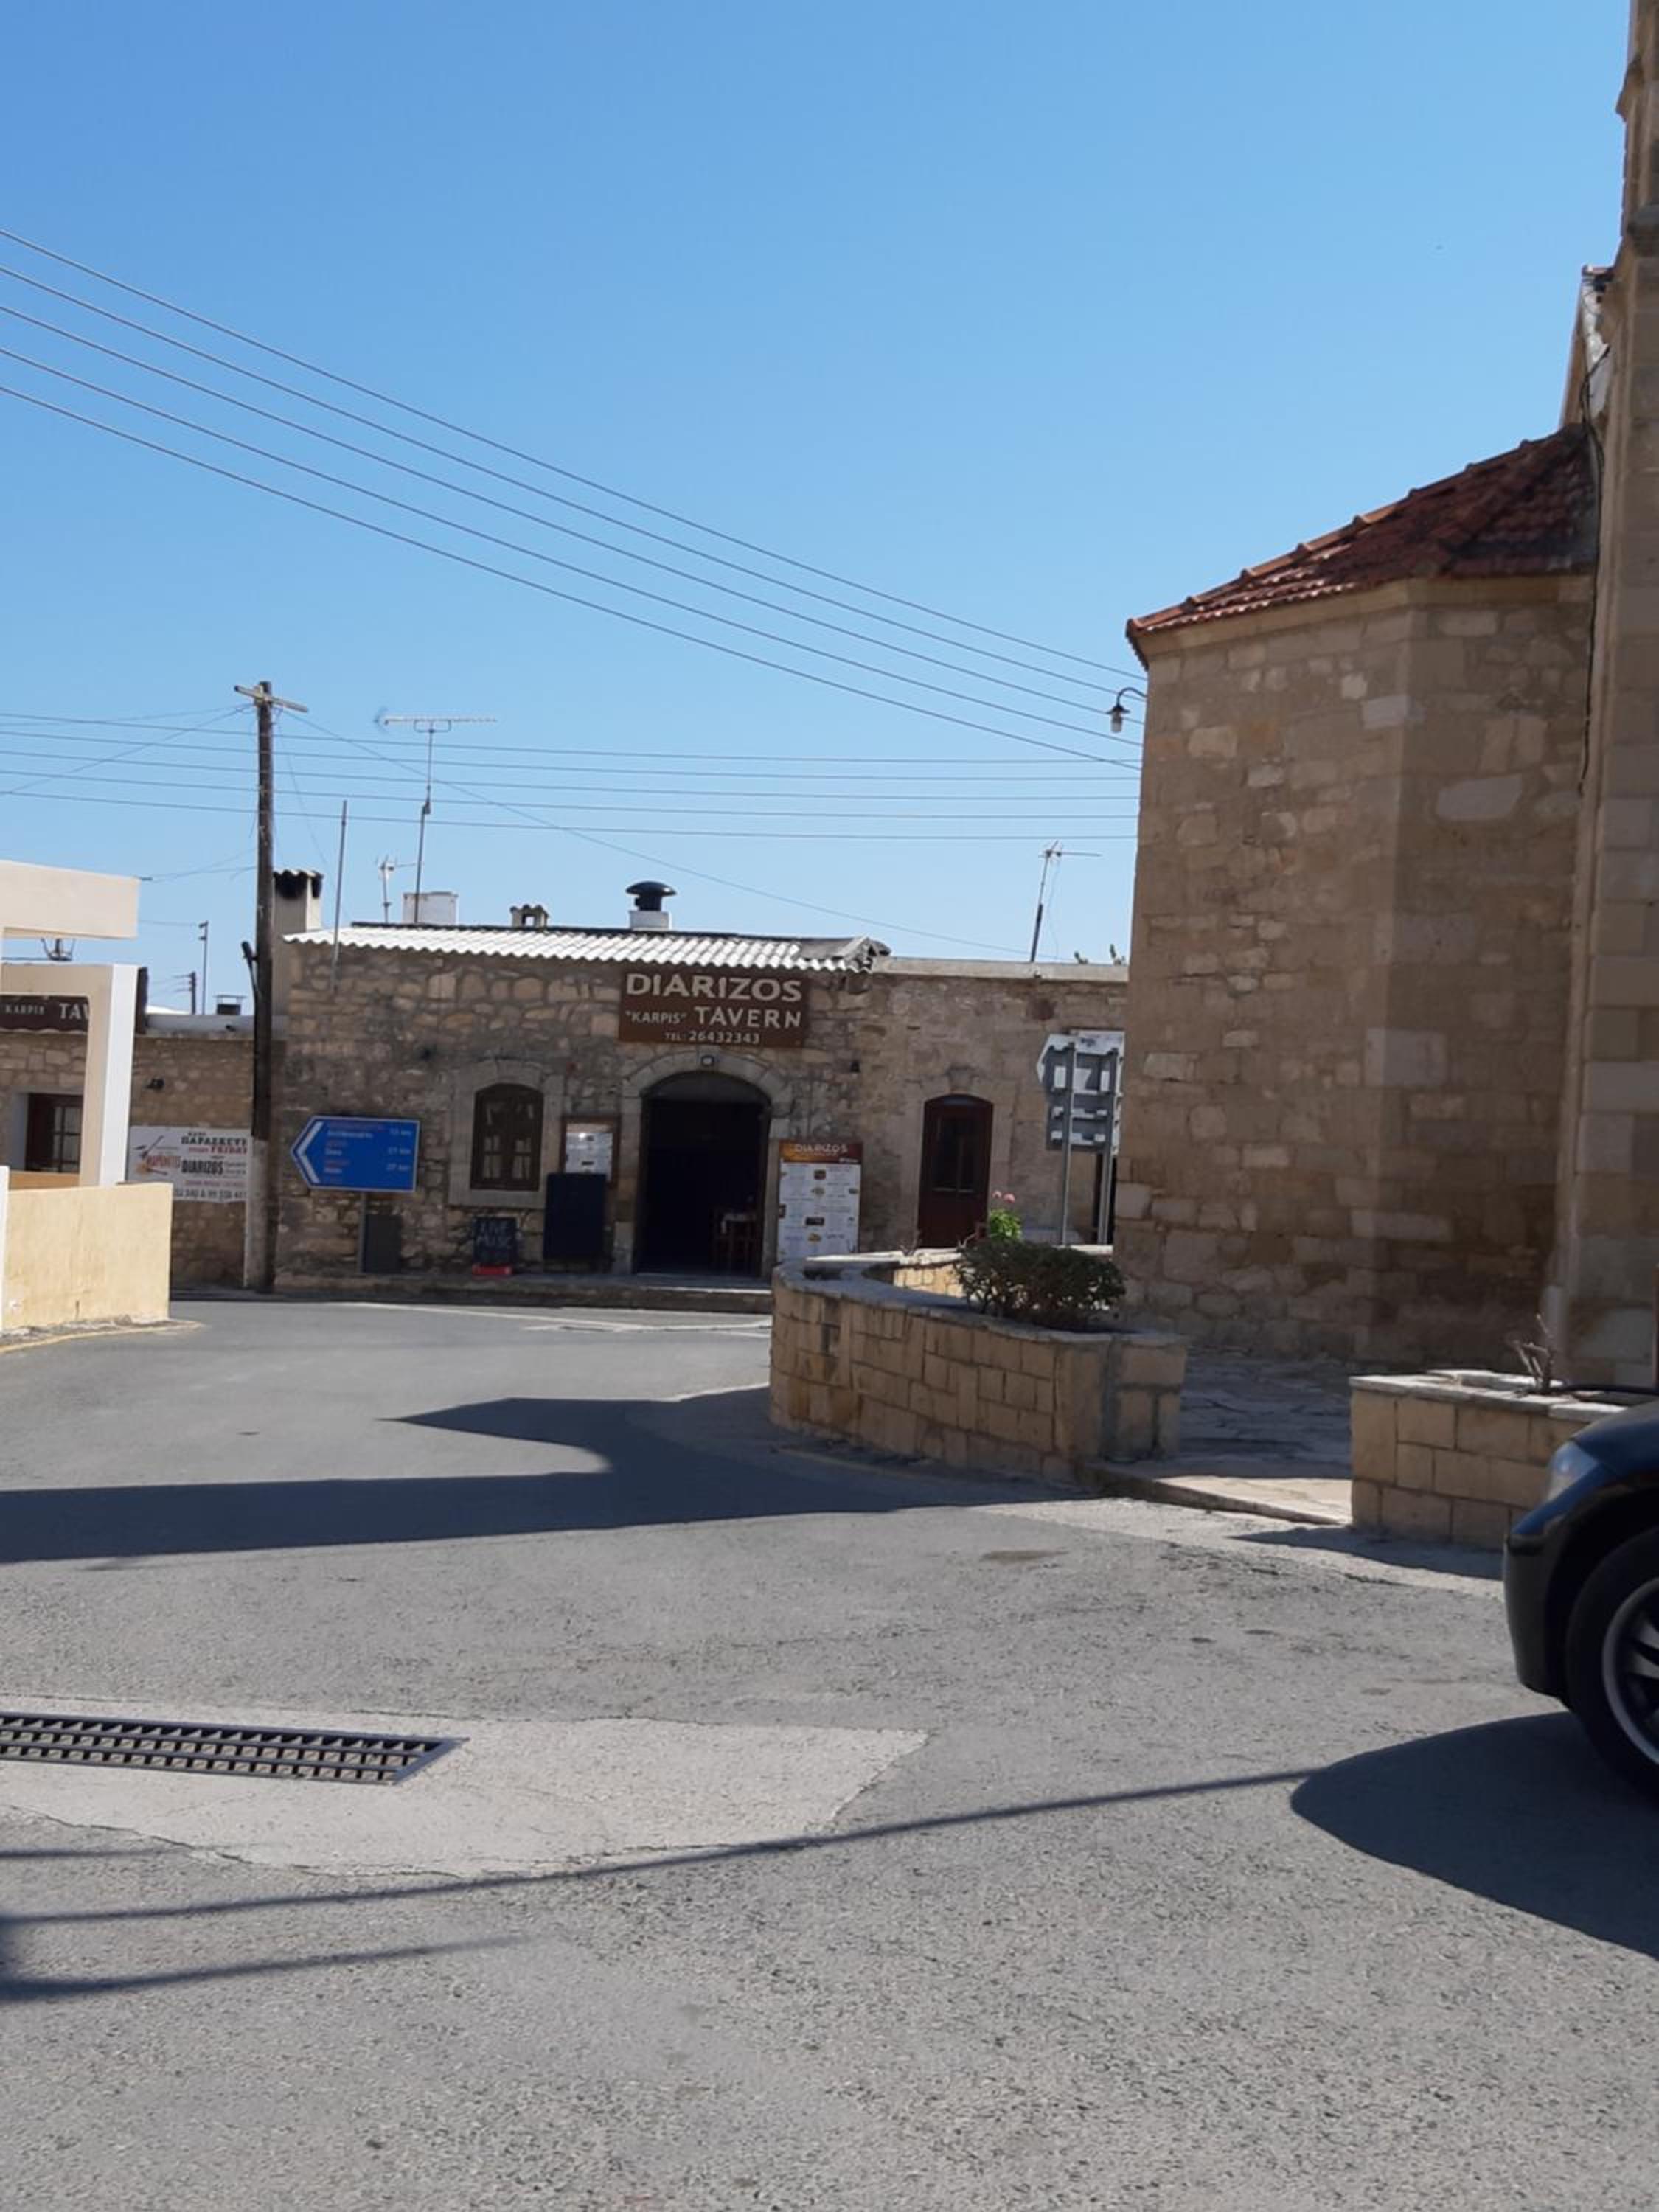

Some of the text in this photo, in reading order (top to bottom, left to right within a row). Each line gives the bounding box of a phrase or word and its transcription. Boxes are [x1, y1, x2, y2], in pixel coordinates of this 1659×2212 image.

[626, 973, 802, 1002] DIARIZOS
[625, 1006, 801, 1028] "KARPIS" TAVERN
[689, 1031, 760, 1044] 26432343
[182, 1160, 223, 1175] DIARIZOS
